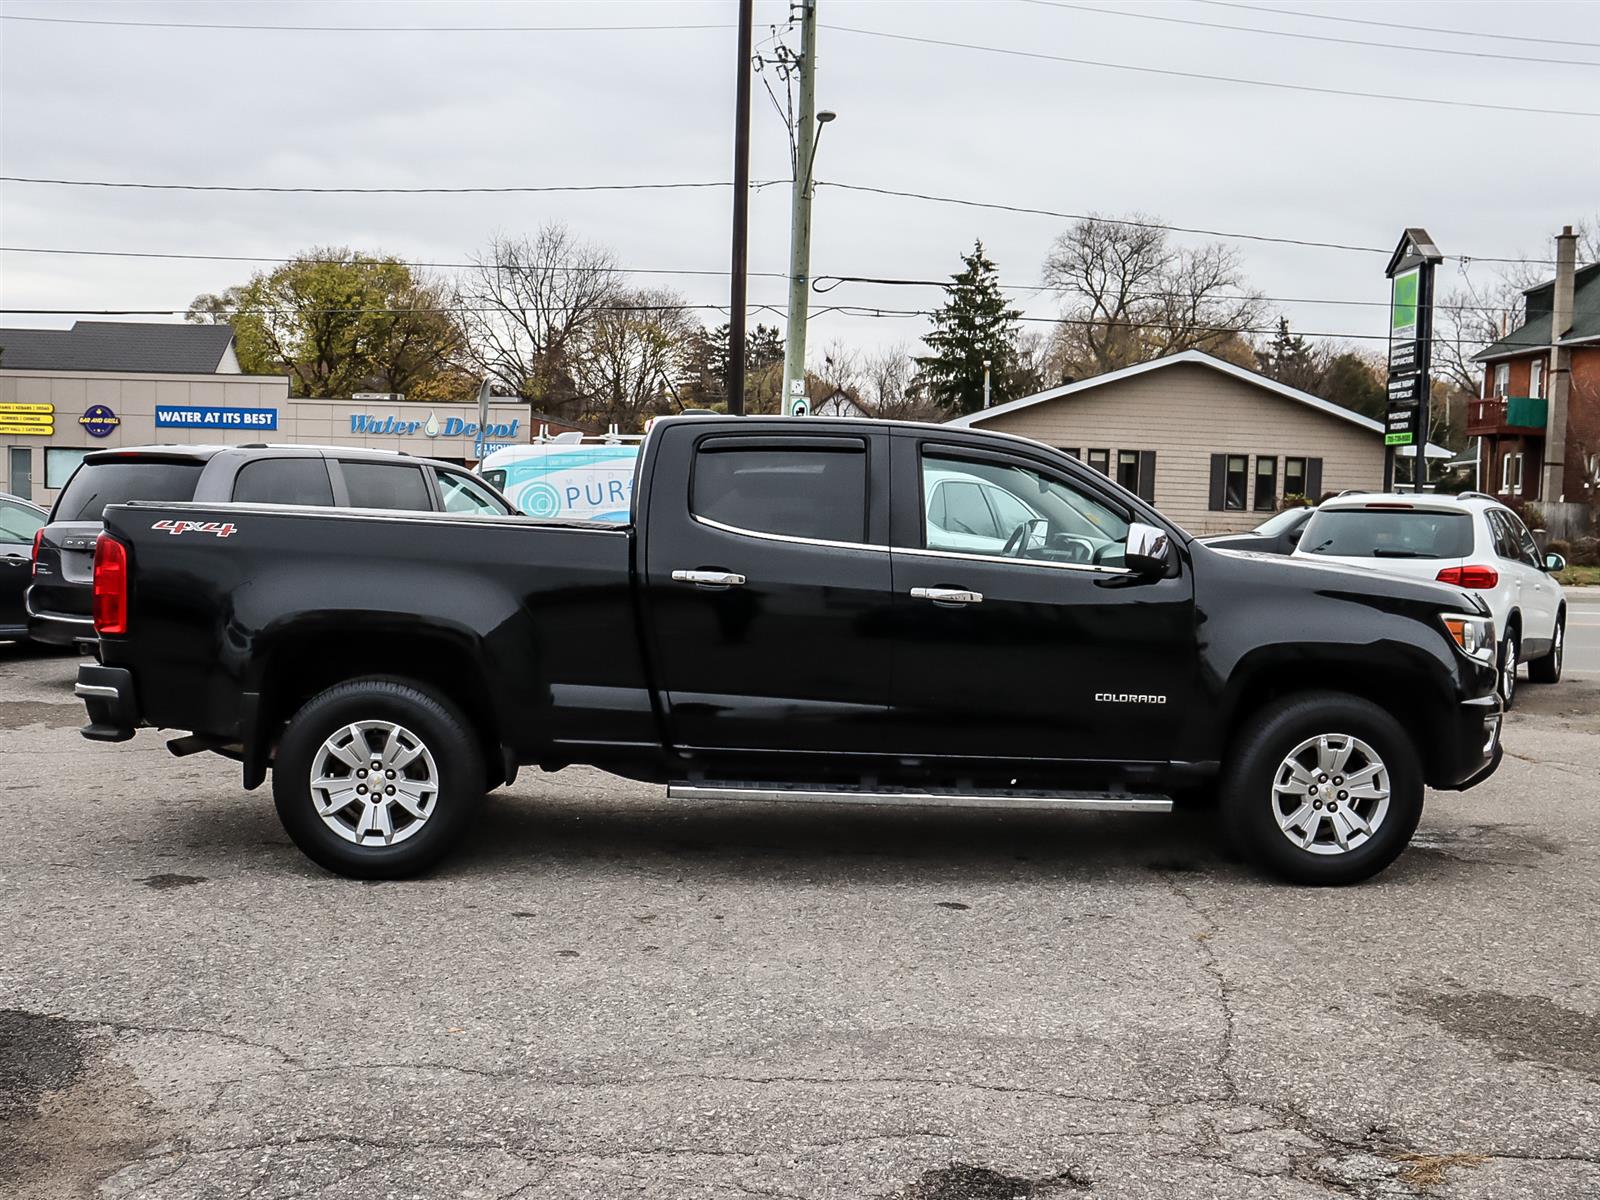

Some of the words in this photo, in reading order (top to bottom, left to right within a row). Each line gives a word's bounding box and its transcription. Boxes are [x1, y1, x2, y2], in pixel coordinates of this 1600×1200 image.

[158, 411, 201, 422] WATER
[204, 413, 219, 423] AT
[222, 413, 241, 423] ITS
[243, 414, 273, 424] BEST
[350, 414, 422, 435] Water
[442, 417, 519, 442] Depot
[1095, 693, 1167, 704] COLORADO
